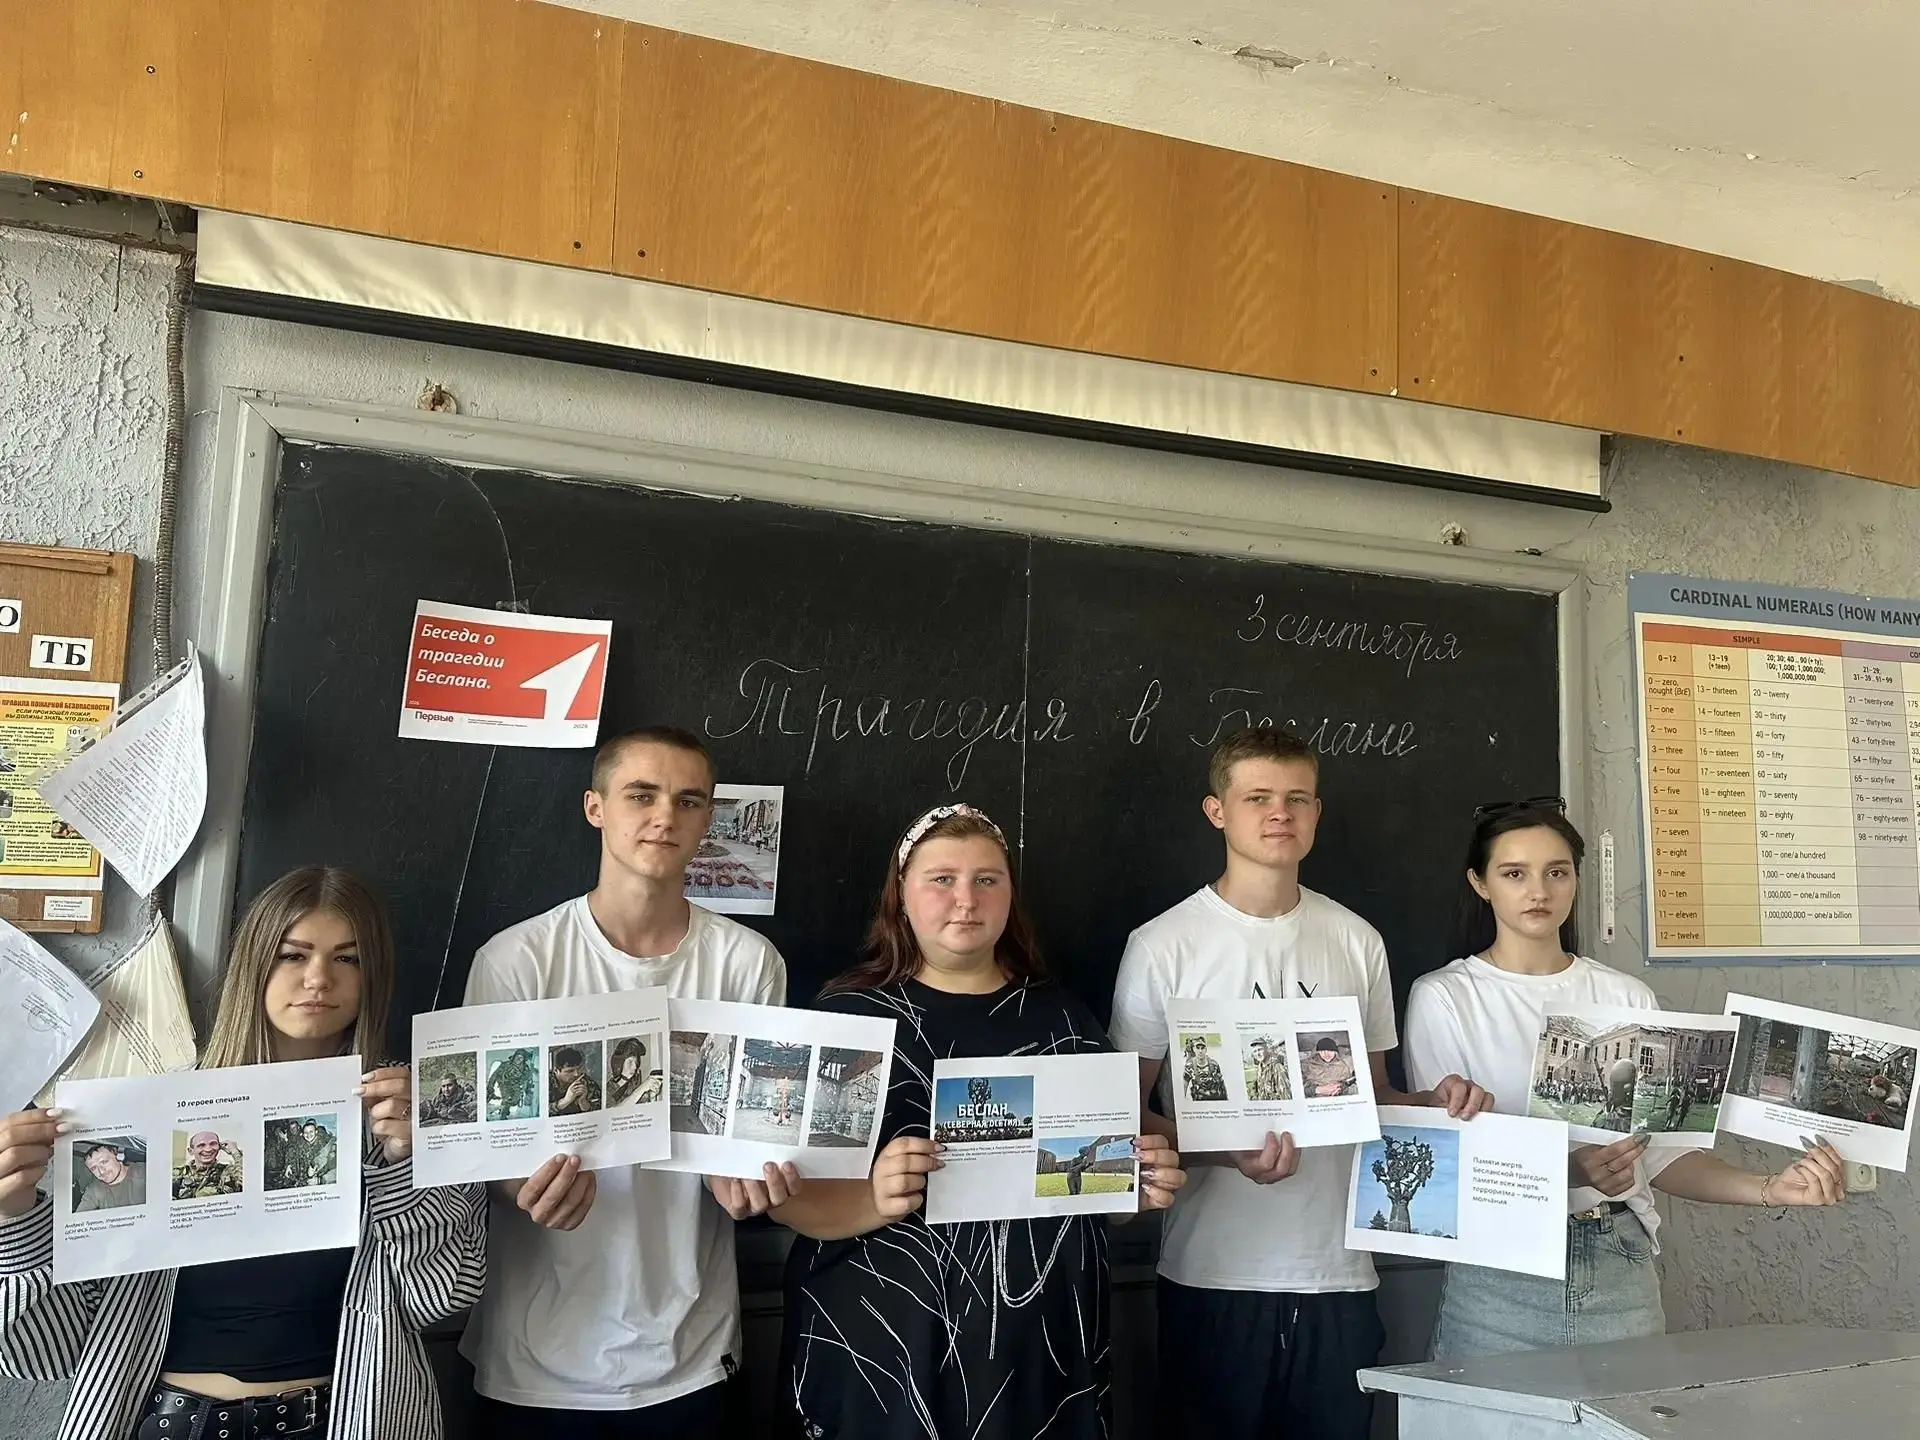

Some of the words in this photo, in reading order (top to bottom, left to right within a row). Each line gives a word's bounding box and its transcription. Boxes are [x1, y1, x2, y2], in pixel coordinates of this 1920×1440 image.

[1670, 588, 1752, 608] CARDINAL
[1756, 596, 1834, 617] NUMERALS
[1838, 603, 1875, 622] (HOW
[421, 624, 480, 643] Беседа
[484, 634, 495, 645] о
[1237, 594, 1267, 641] 3
[1276, 614, 1463, 677] сентября
[1733, 636, 1760, 645] SIMPLE
[40, 641, 85, 665] ТБ
[418, 649, 504, 668] трагедии
[416, 669, 491, 689] Беслана.
[1649, 687, 1672, 696] nought
[1675, 688, 1690, 697] (BrE)
[1697, 685, 1704, 693] 13
[1713, 687, 1737, 695] thirteen
[1753, 689, 1761, 697] 20
[1769, 691, 1790, 699] twenty
[1864, 697, 1893, 706] twenty-one
[415, 711, 454, 722] Первые
[1714, 708, 1741, 717] fourteen
[1755, 711, 1762, 719] 30
[1770, 713, 1786, 721] thirty
[705, 658, 1075, 792] Трагедия
[1126, 679, 1163, 745] в
[1850, 717, 1858, 725] 32
[1866, 719, 1891, 728] thirty-two
[1651, 725, 1655, 733] 2
[1664, 726, 1677, 734] two
[1715, 728, 1735, 737] fifteen
[1771, 732, 1785, 741] forty
[1868, 737, 1895, 746] forty-three
[1666, 746, 1683, 754] three
[1700, 748, 1707, 756] 16
[1716, 749, 1739, 757] sixteen
[1772, 752, 1784, 761] fifty
[1869, 756, 1892, 765] fifty-four
[1667, 766, 1680, 774] four
[1717, 768, 1750, 777] seventeen
[1773, 772, 1787, 780] sixty
[1871, 776, 1895, 784] sixty-five
[1654, 786, 1658, 794] 5
[1668, 786, 1680, 794] five
[1718, 788, 1745, 798] eighteen
[1774, 792, 1798, 800] seventy
[1856, 794, 1864, 802] 76
[1718, 809, 1746, 817] nineteen
[1760, 810, 1767, 818] 80
[1775, 811, 1793, 820] eighty
[1874, 814, 1909, 824] eighty-seven
[1656, 827, 1660, 835] 7
[1776, 831, 1794, 840] ninety
[1859, 833, 1866, 841] 98
[1875, 834, 1907, 843] ninety-eight
[1656, 848, 1661, 856] 8
[1670, 848, 1687, 858] eight
[1800, 851, 1826, 860] hundred
[1763, 871, 1778, 879] 1,000
[1806, 871, 1836, 879] thousand
[1764, 890, 1791, 899] 1,000,000
[1659, 910, 1666, 918] 11
[1676, 911, 1697, 919] eleven
[1764, 911, 1805, 919] 1,000,000,000
[1834, 911, 1852, 919] billion
[1678, 932, 1699, 940] twelve
[177, 1100, 186, 1108] 10
[188, 1098, 214, 1107] героев
[215, 1094, 250, 1104] спецназа
[958, 1103, 1008, 1117] БЕСЛАН
[944, 1120, 987, 1128] (СЕВЕРНАЯ
[990, 1119, 1020, 1127] ОСЕТИЯ)
[1473, 1157, 1499, 1165] Памяти
[1473, 1167, 1514, 1177] Бесланской
[1473, 1187, 1515, 1196] терроризма
